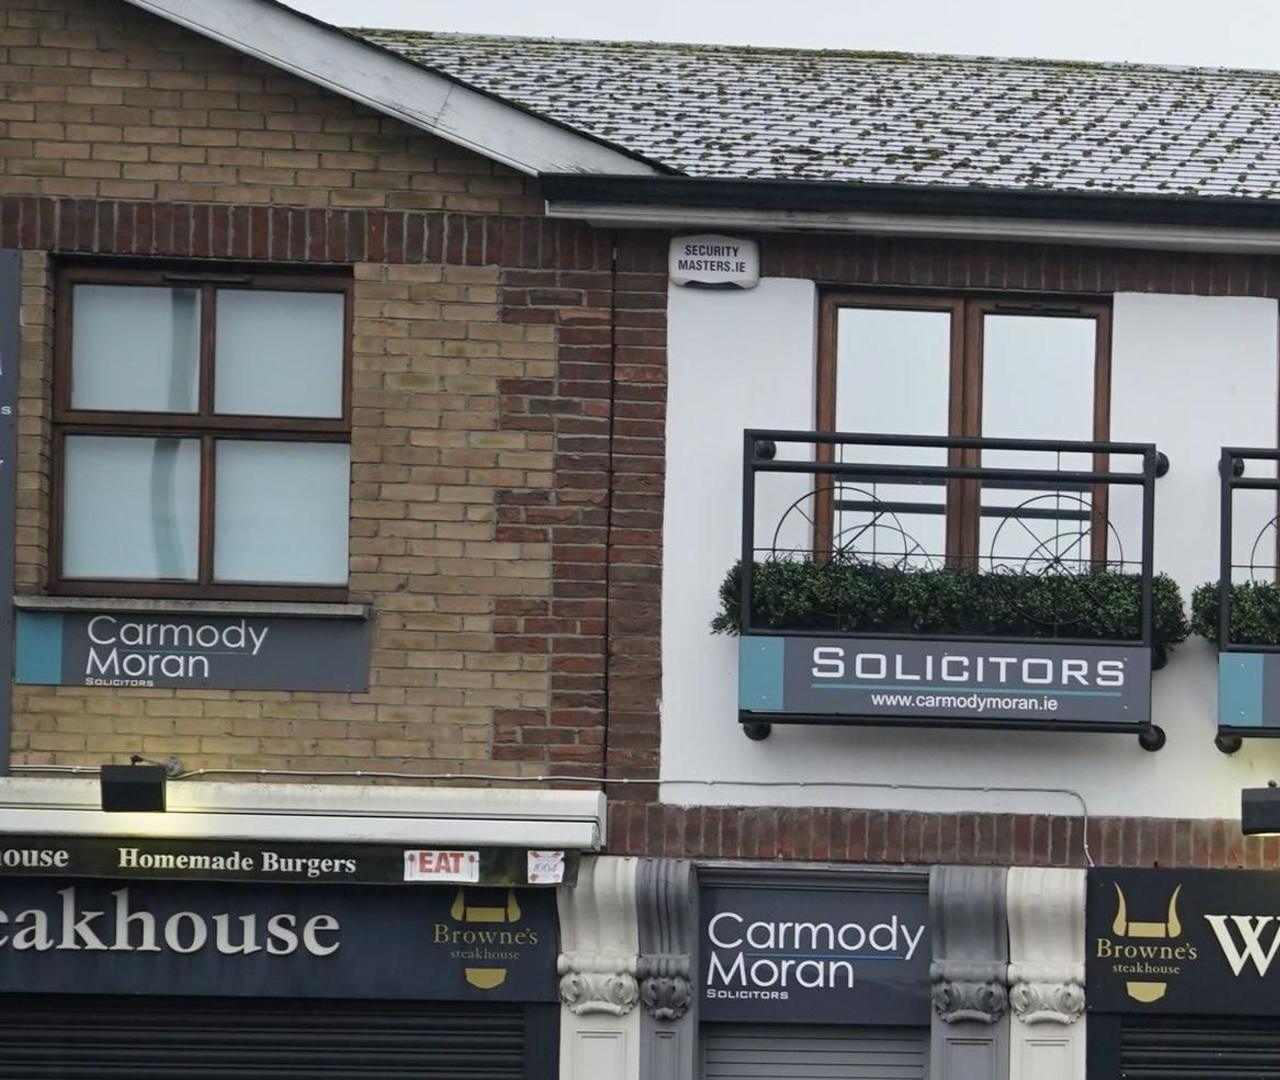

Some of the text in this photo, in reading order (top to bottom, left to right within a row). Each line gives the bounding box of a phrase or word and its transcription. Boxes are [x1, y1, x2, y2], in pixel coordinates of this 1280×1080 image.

[684, 245, 740, 257] SECURITY
[678, 259, 746, 273] MASTERS.IE
[87, 615, 270, 656] Carmody
[85, 647, 209, 678] Moran
[811, 646, 1125, 686] SOLICITORS
[871, 693, 1059, 712] www.carmodymoran.ie
[0, 848, 69, 868] ouse
[118, 848, 357, 878] Homemade Burgers
[418, 852, 464, 874] EAT
[0, 886, 341, 957] akhouse
[432, 923, 539, 945] Browne's
[708, 912, 926, 960] Carmody
[450, 949, 520, 961] steakhouse
[1096, 938, 1197, 960] Browne's
[706, 951, 854, 989] Moran
[1112, 962, 1181, 975] steakhouse
[706, 988, 789, 1000] SOLICITORS
